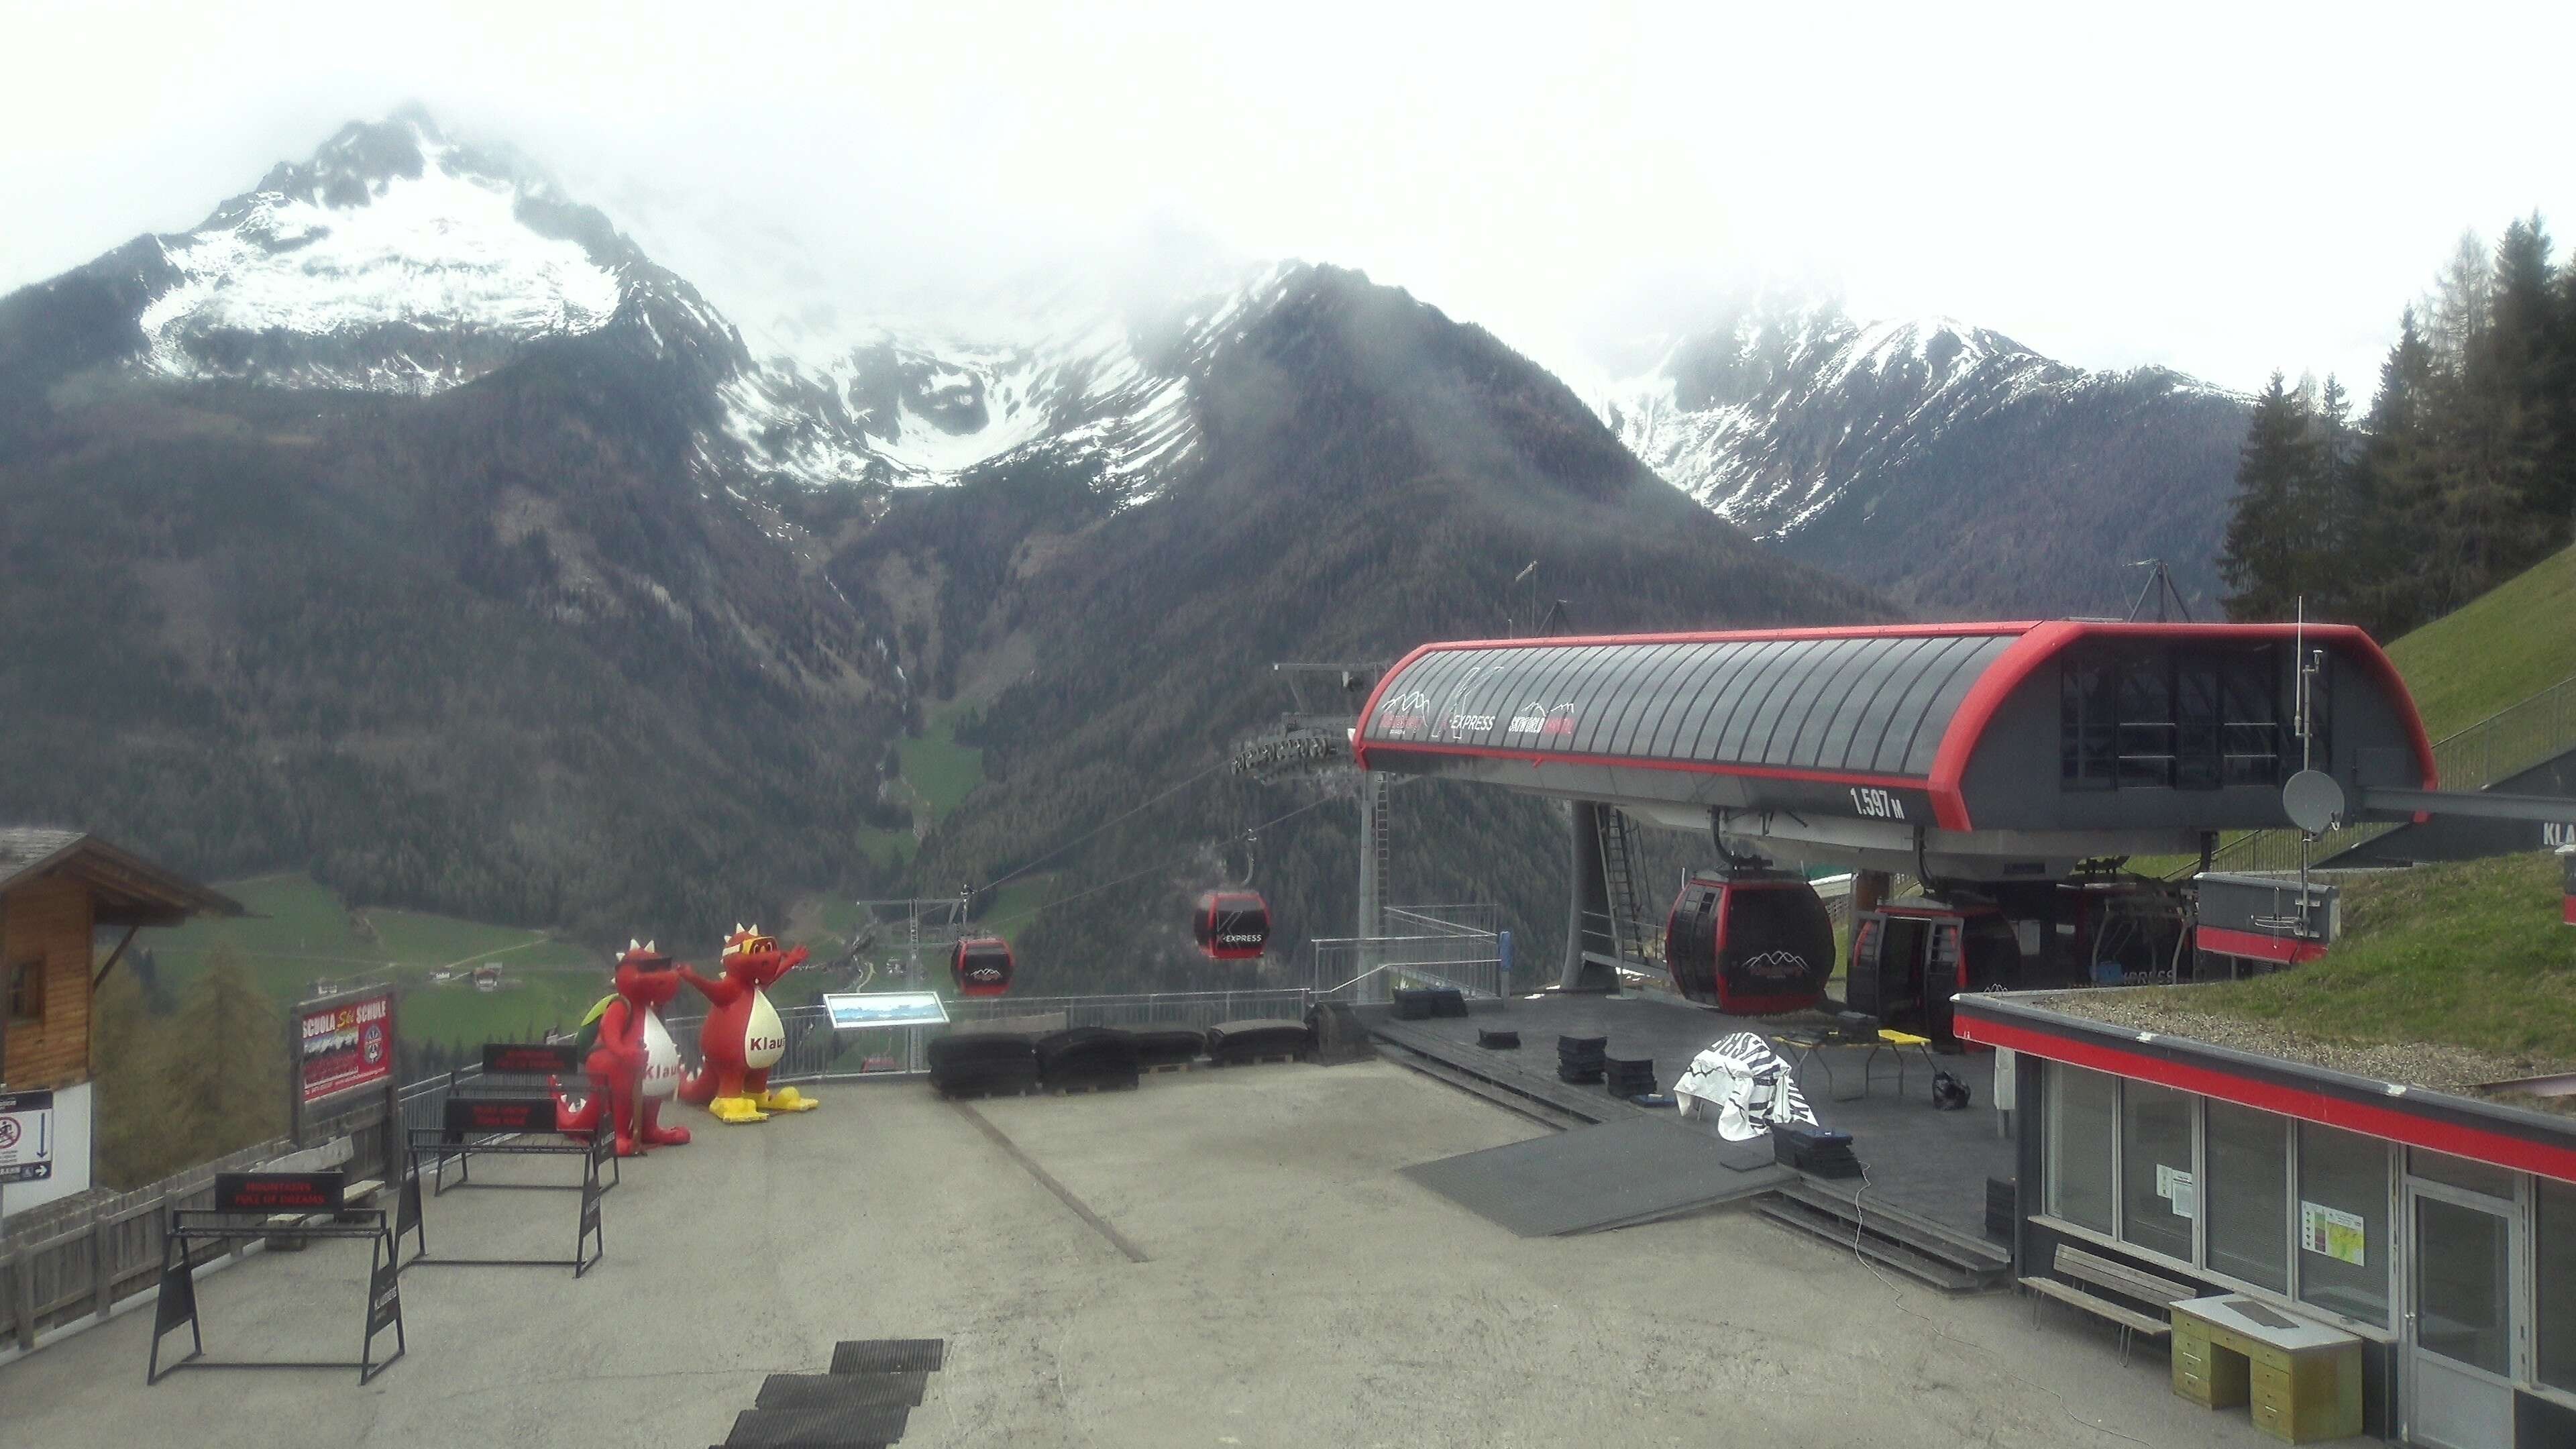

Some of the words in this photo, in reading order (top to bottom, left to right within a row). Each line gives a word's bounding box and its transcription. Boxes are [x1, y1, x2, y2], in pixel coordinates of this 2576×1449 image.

[1850, 788, 1890, 818] 1.597
[1891, 798, 1905, 819] M
[303, 1014, 335, 1039] SCUOLA
[356, 1000, 387, 1024] SCHULE
